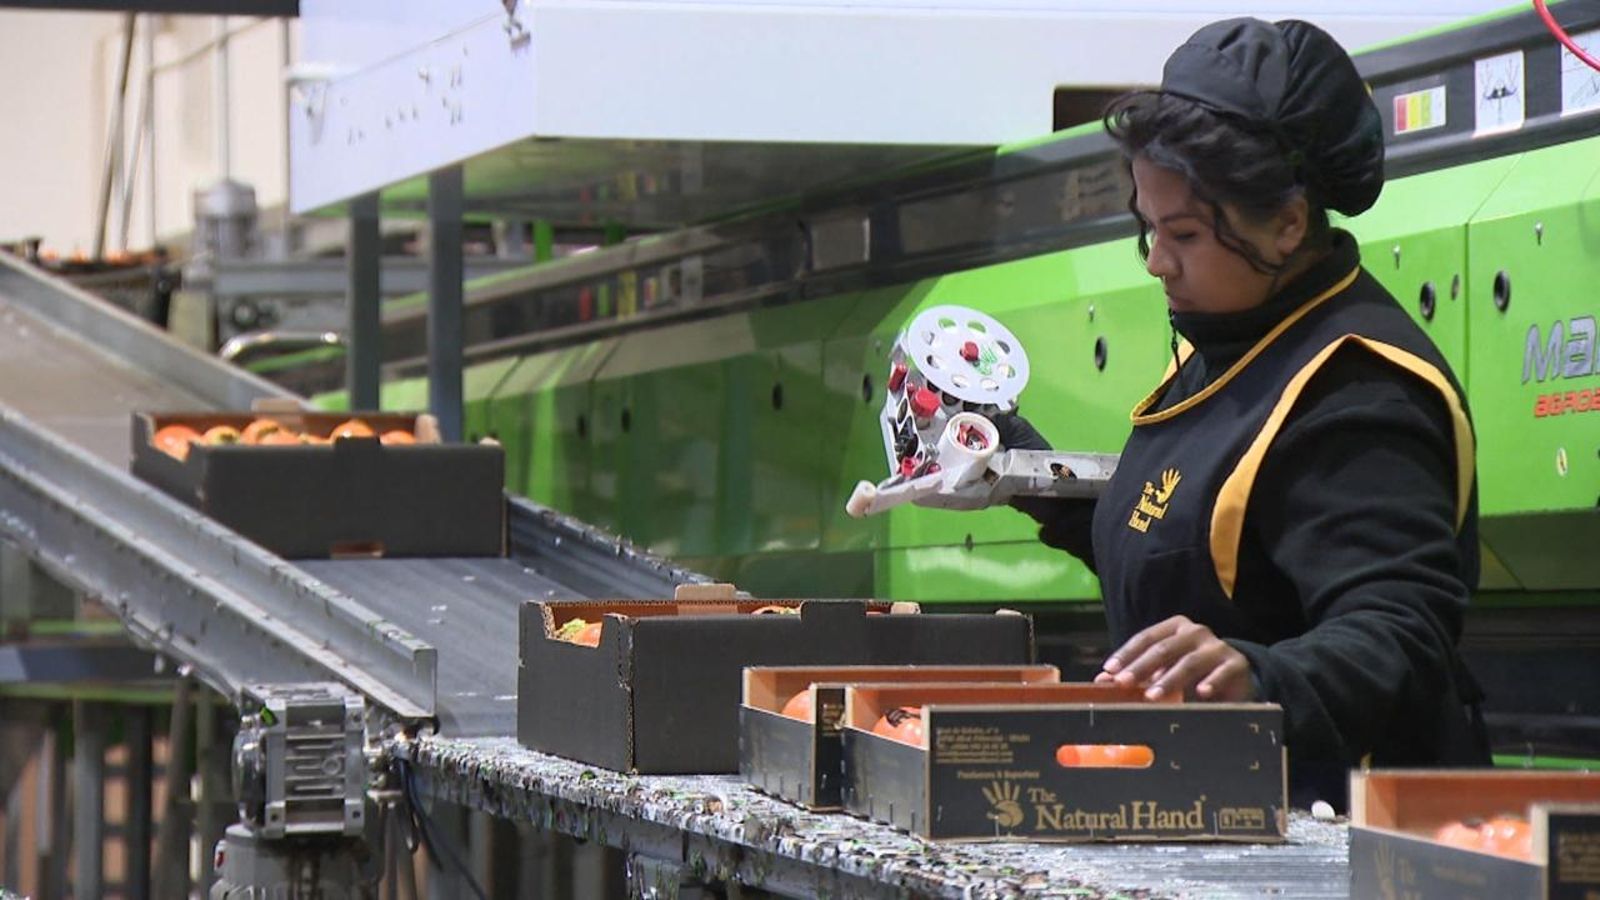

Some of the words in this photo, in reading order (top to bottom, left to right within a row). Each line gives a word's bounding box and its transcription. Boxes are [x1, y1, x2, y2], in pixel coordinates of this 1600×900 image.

[1135, 493, 1169, 519] Natural
[1128, 509, 1152, 533] Hand
[1027, 787, 1057, 803] The
[1035, 803, 1128, 830] Natural
[1131, 801, 1205, 830] Hand
